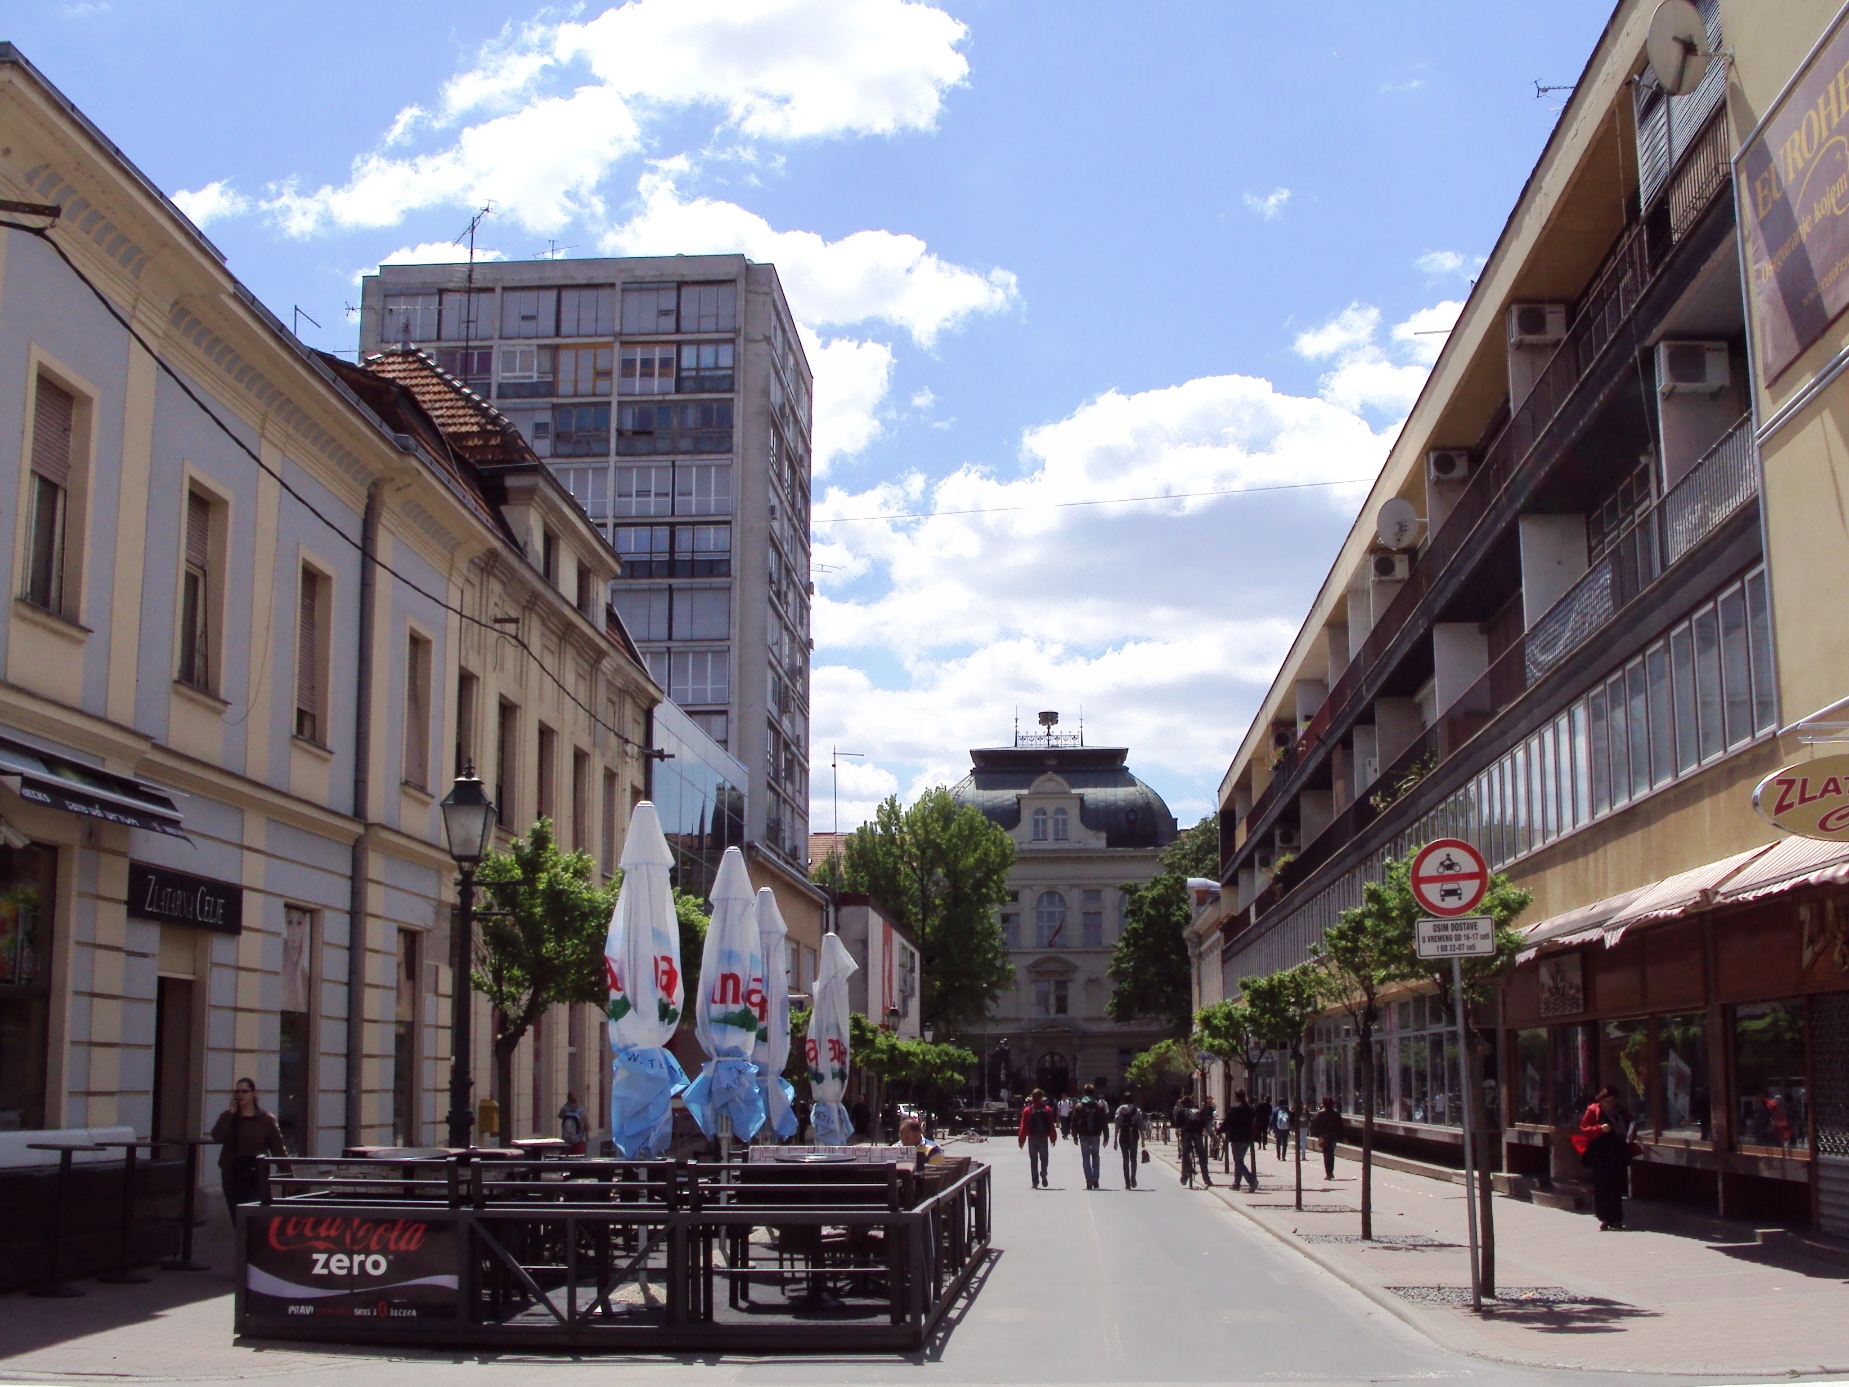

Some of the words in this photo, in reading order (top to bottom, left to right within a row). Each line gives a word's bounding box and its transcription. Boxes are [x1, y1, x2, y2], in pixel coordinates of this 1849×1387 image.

[1433, 923, 1449, 932] OSIM
[1450, 921, 1478, 932] DOSTAVE
[1422, 935, 1426, 943] U
[1427, 934, 1453, 943] VREMENU
[1454, 934, 1462, 942] OD
[1463, 933, 1479, 941] 16-17
[1441, 944, 1448, 952] OD
[1449, 943, 1465, 952] 22-07
[312, 1252, 388, 1276] zero
